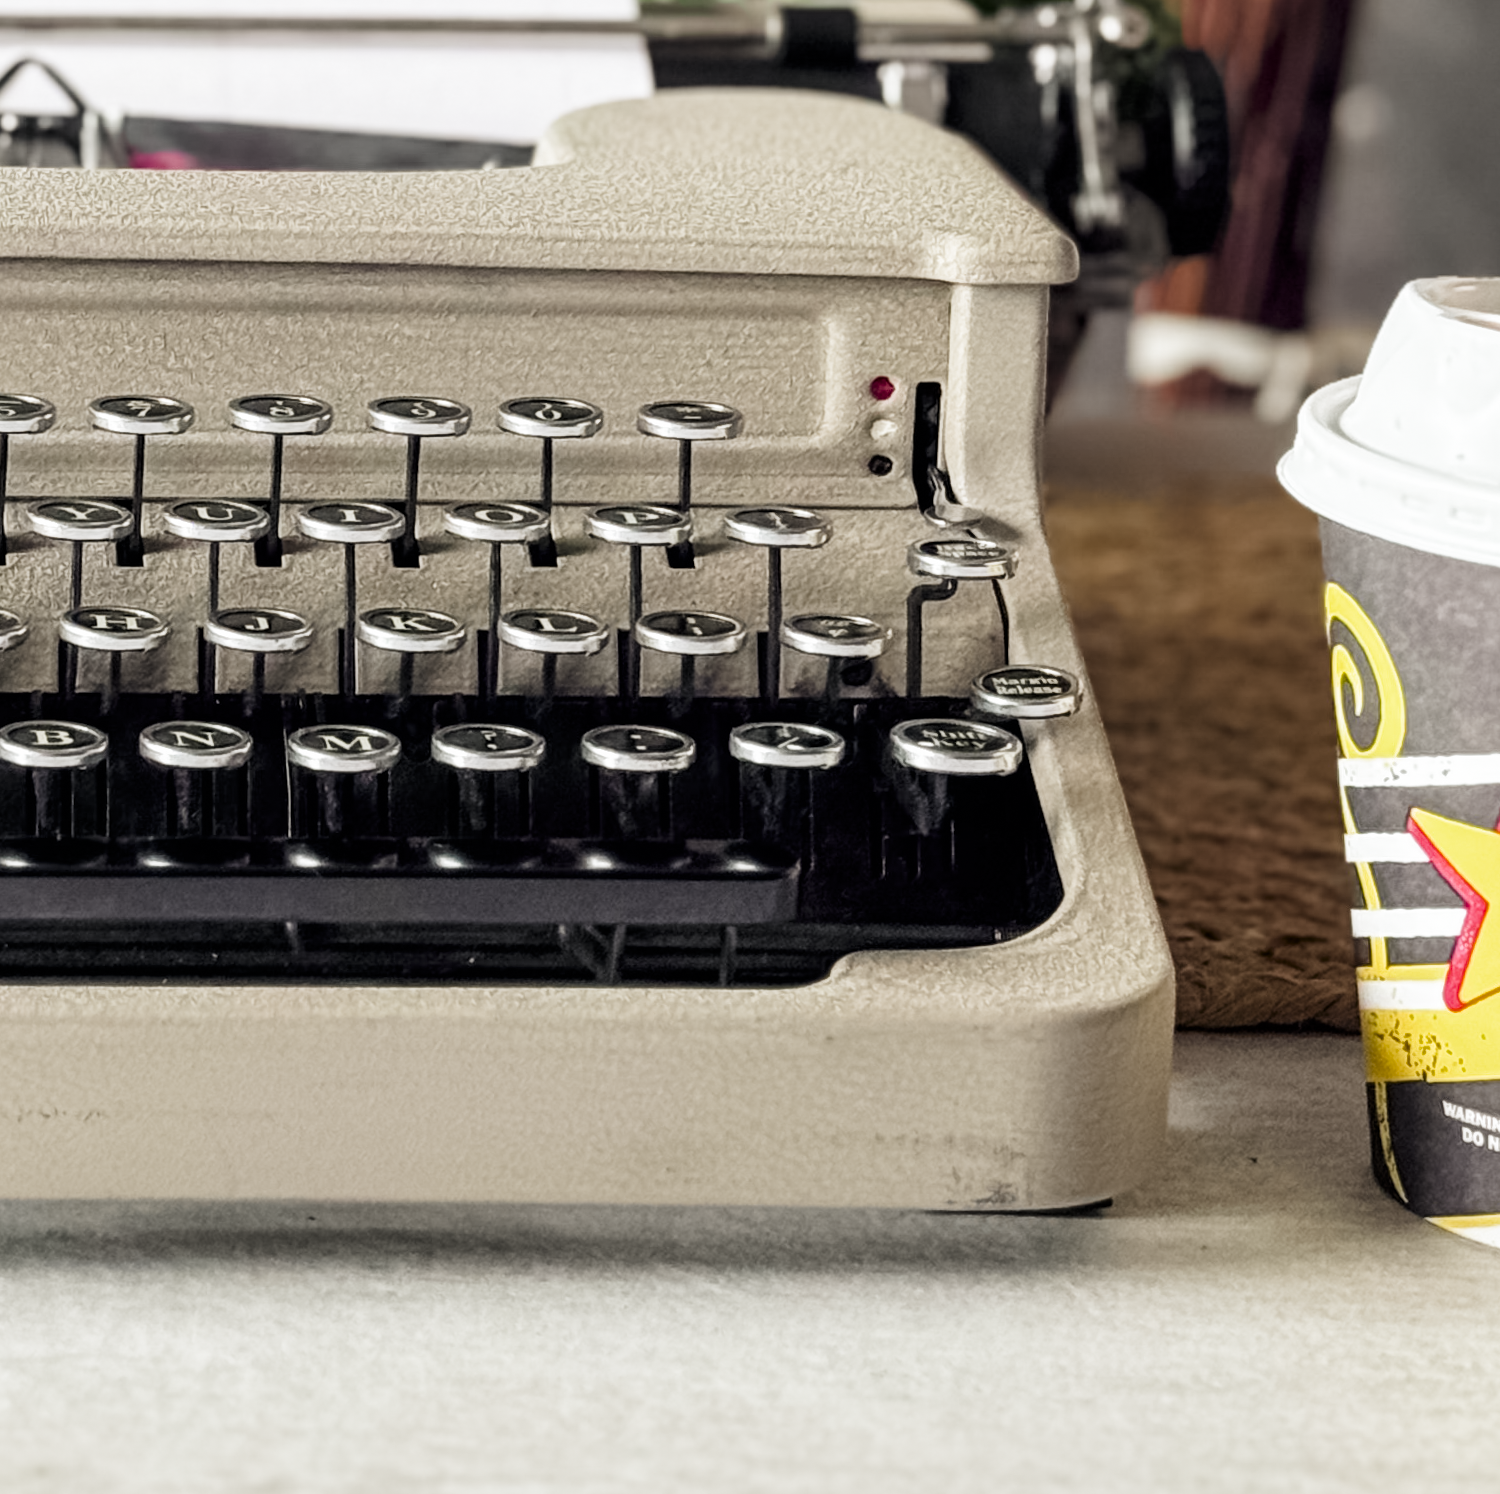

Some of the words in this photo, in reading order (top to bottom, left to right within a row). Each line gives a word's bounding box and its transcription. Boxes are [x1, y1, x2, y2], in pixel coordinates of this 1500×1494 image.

[129, 405, 152, 417] 7
[269, 406, 295, 417] 8
[60, 506, 103, 520] Y
[192, 506, 235, 521] U
[339, 508, 361, 523] I
[473, 508, 524, 523] O
[619, 511, 661, 525] P
[92, 614, 142, 630] H
[243, 616, 271, 631] J
[389, 616, 439, 632] K
[534, 616, 577, 633] L
[996, 685, 1062, 695] Release
[31, 729, 75, 746] B
[172, 731, 216, 748] N
[321, 734, 373, 751] M
[931, 737, 986, 750] Key
[1461, 1126, 1484, 1147] DO
